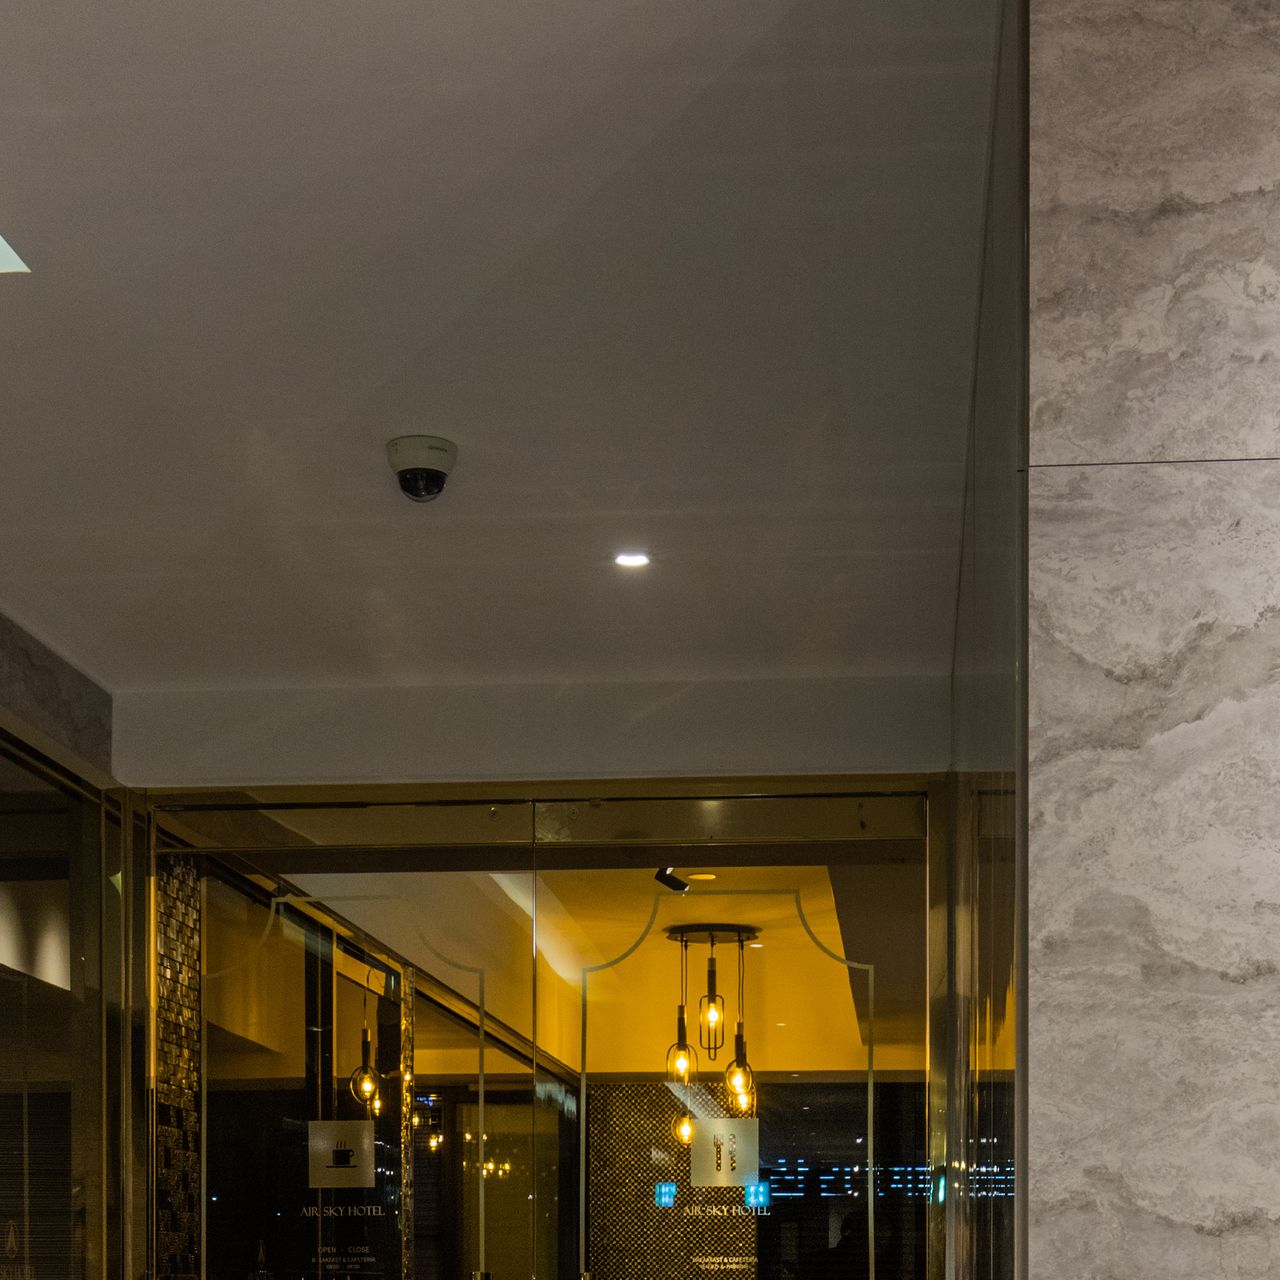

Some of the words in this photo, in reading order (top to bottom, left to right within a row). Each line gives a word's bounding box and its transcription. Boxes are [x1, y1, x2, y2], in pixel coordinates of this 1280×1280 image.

[300, 1206, 320, 1217] AIR
[323, 1206, 345, 1217] SKY
[348, 1205, 385, 1216] HOTEL
[684, 1205, 703, 1216] AIR
[706, 1205, 728, 1216] SKY
[732, 1205, 771, 1216] HOTEL
[318, 1246, 337, 1254] OPEN
